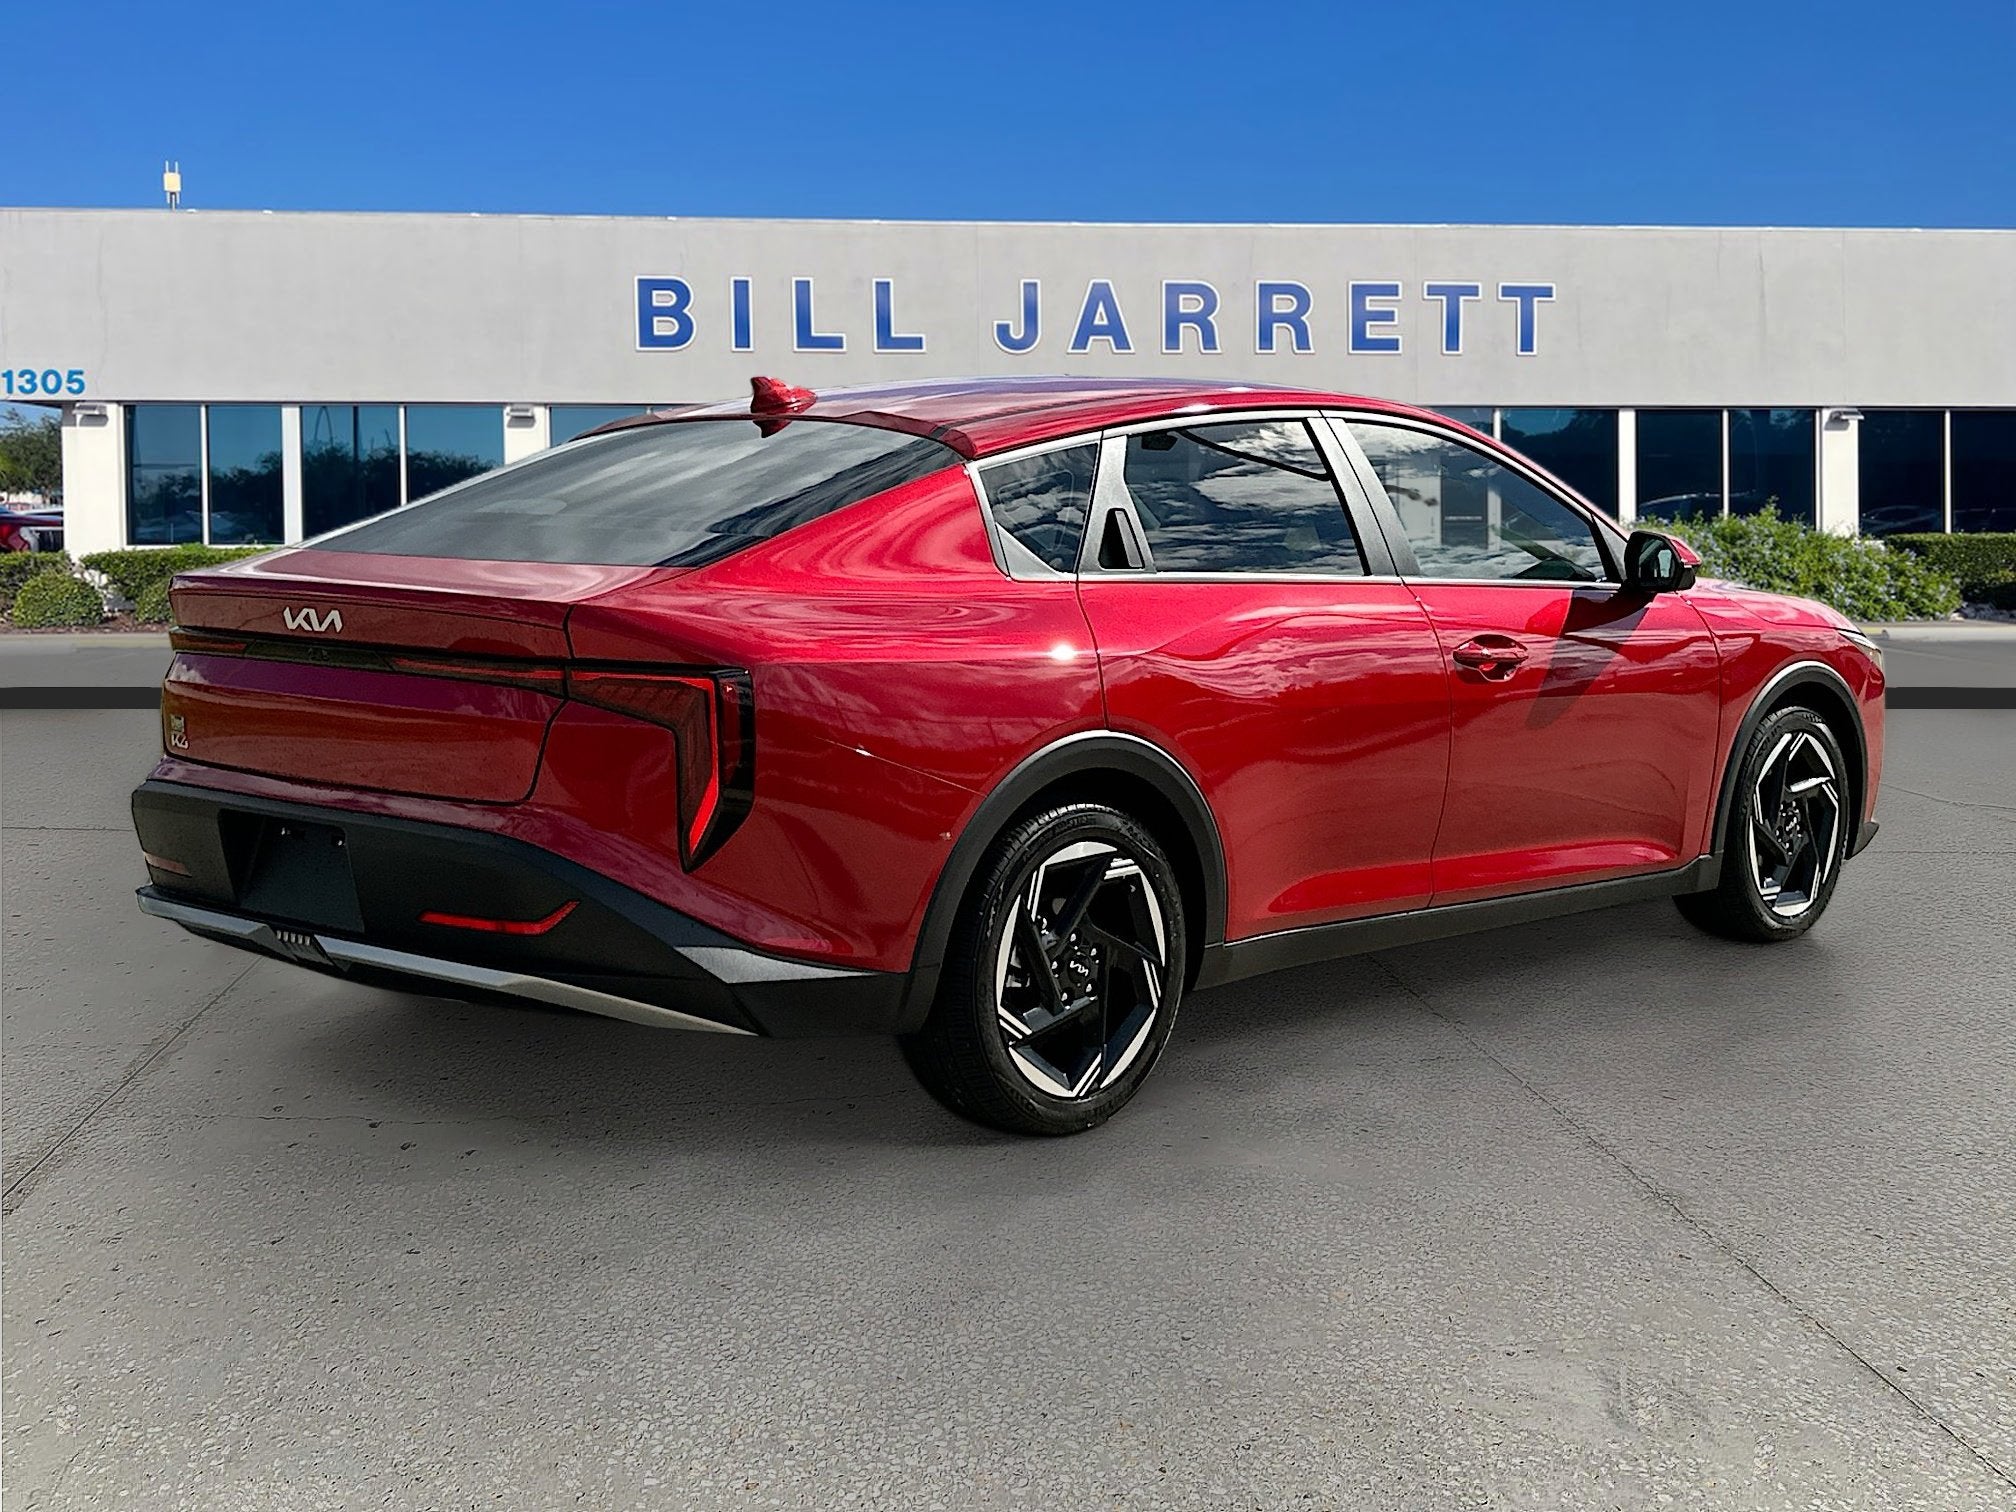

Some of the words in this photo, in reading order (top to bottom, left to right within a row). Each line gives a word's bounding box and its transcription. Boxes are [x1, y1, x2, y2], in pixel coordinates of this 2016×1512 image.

[634, 275, 926, 352] BILL
[993, 279, 1556, 356] JARRETT
[1, 369, 85, 394] 1305
[283, 606, 343, 633] KIA
